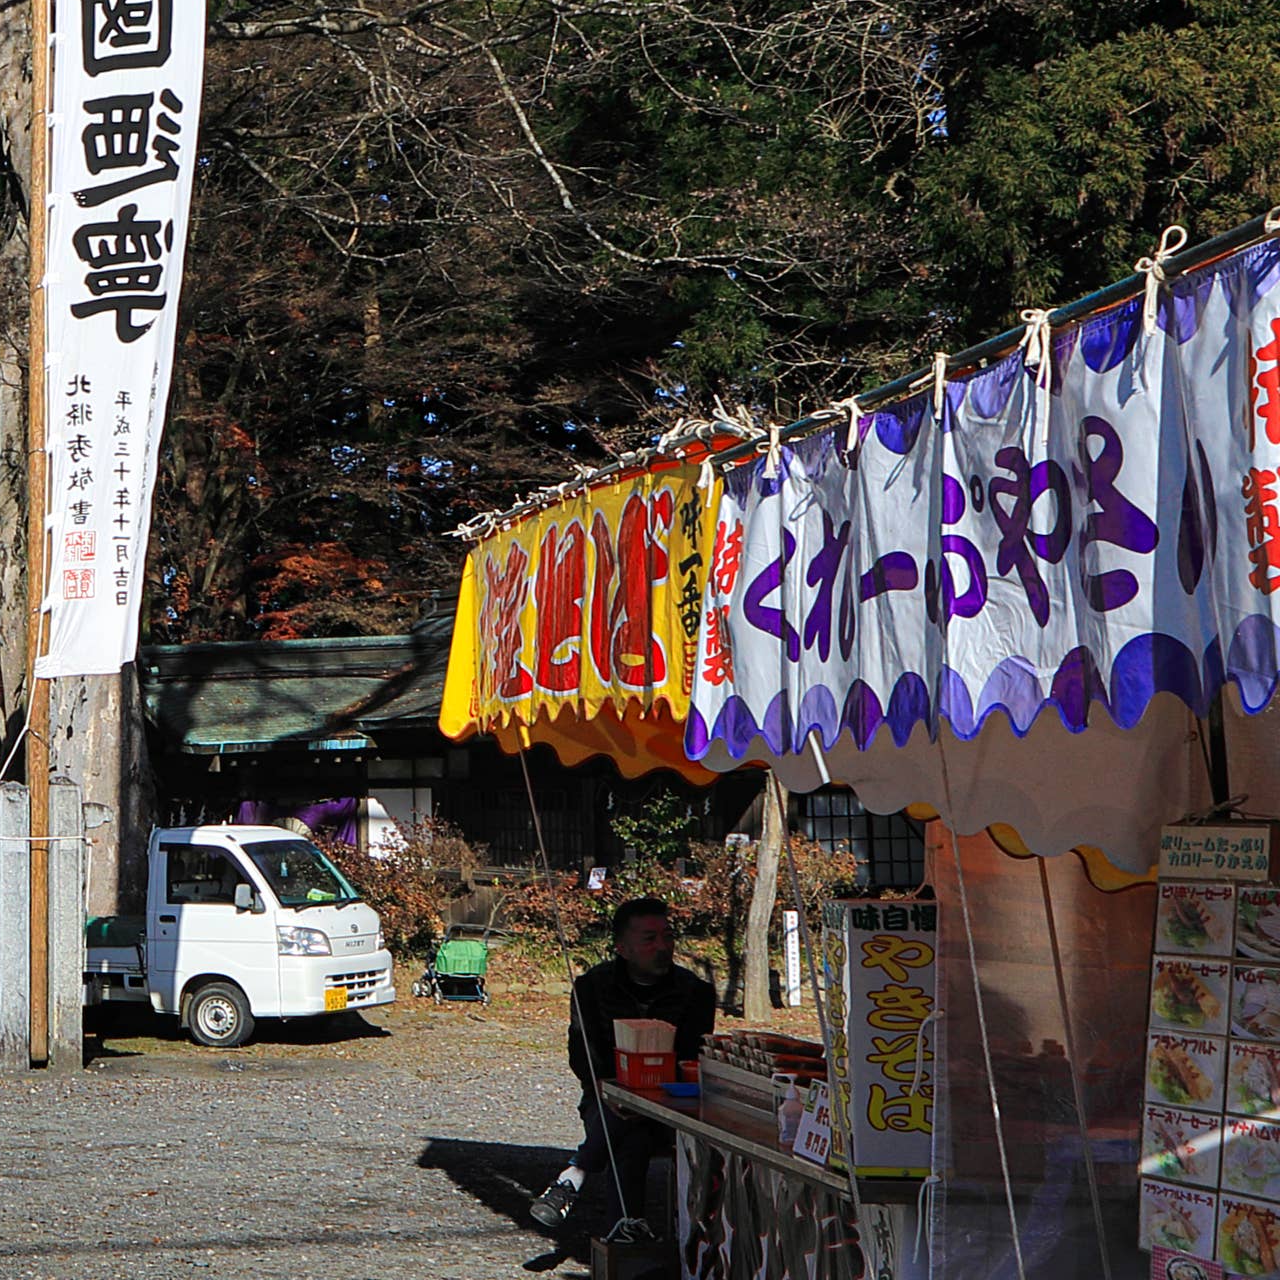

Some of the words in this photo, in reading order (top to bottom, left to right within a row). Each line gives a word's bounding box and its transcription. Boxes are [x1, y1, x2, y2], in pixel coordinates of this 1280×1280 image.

[861, 934, 936, 1134] やきそば
[1151, 1034, 1217, 1056] フランクフルト
[1147, 1107, 1219, 1131] チーズソーセージ
